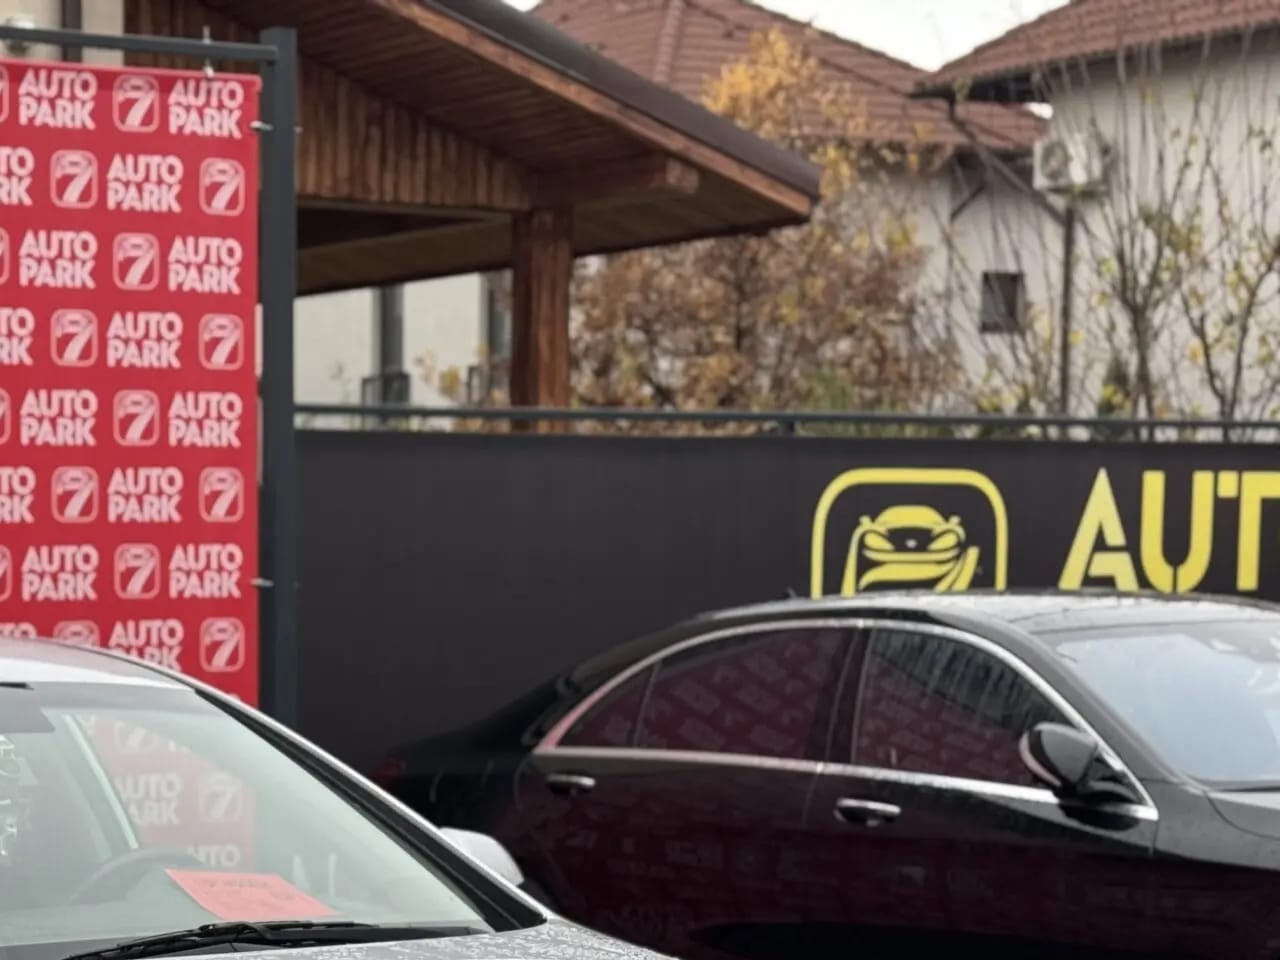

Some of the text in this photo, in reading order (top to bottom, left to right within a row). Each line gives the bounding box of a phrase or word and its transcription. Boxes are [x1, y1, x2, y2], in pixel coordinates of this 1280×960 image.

[19, 69, 98, 99] AUTO
[168, 78, 243, 107] AUTO
[19, 97, 95, 129] PARK
[169, 105, 241, 138] PARK
[107, 154, 183, 182] AUTO
[107, 182, 181, 212] PARK
[19, 230, 97, 259] AUTO
[168, 236, 242, 264] AUTO
[20, 259, 95, 288] PARK
[169, 264, 240, 294] PARK
[107, 312, 182, 339] AUTO
[107, 339, 180, 368] PARK
[20, 390, 97, 417] AUTO
[169, 392, 242, 418] AUTO
[21, 417, 95, 445] PARK
[169, 418, 240, 447] PARK
[108, 467, 183, 495] AUTO
[109, 495, 180, 522] PARK
[22, 545, 98, 574] AUTO
[169, 544, 242, 571] AUTO
[23, 572, 96, 600] PARK
[170, 571, 240, 597] PARK
[108, 619, 184, 648] AUTO
